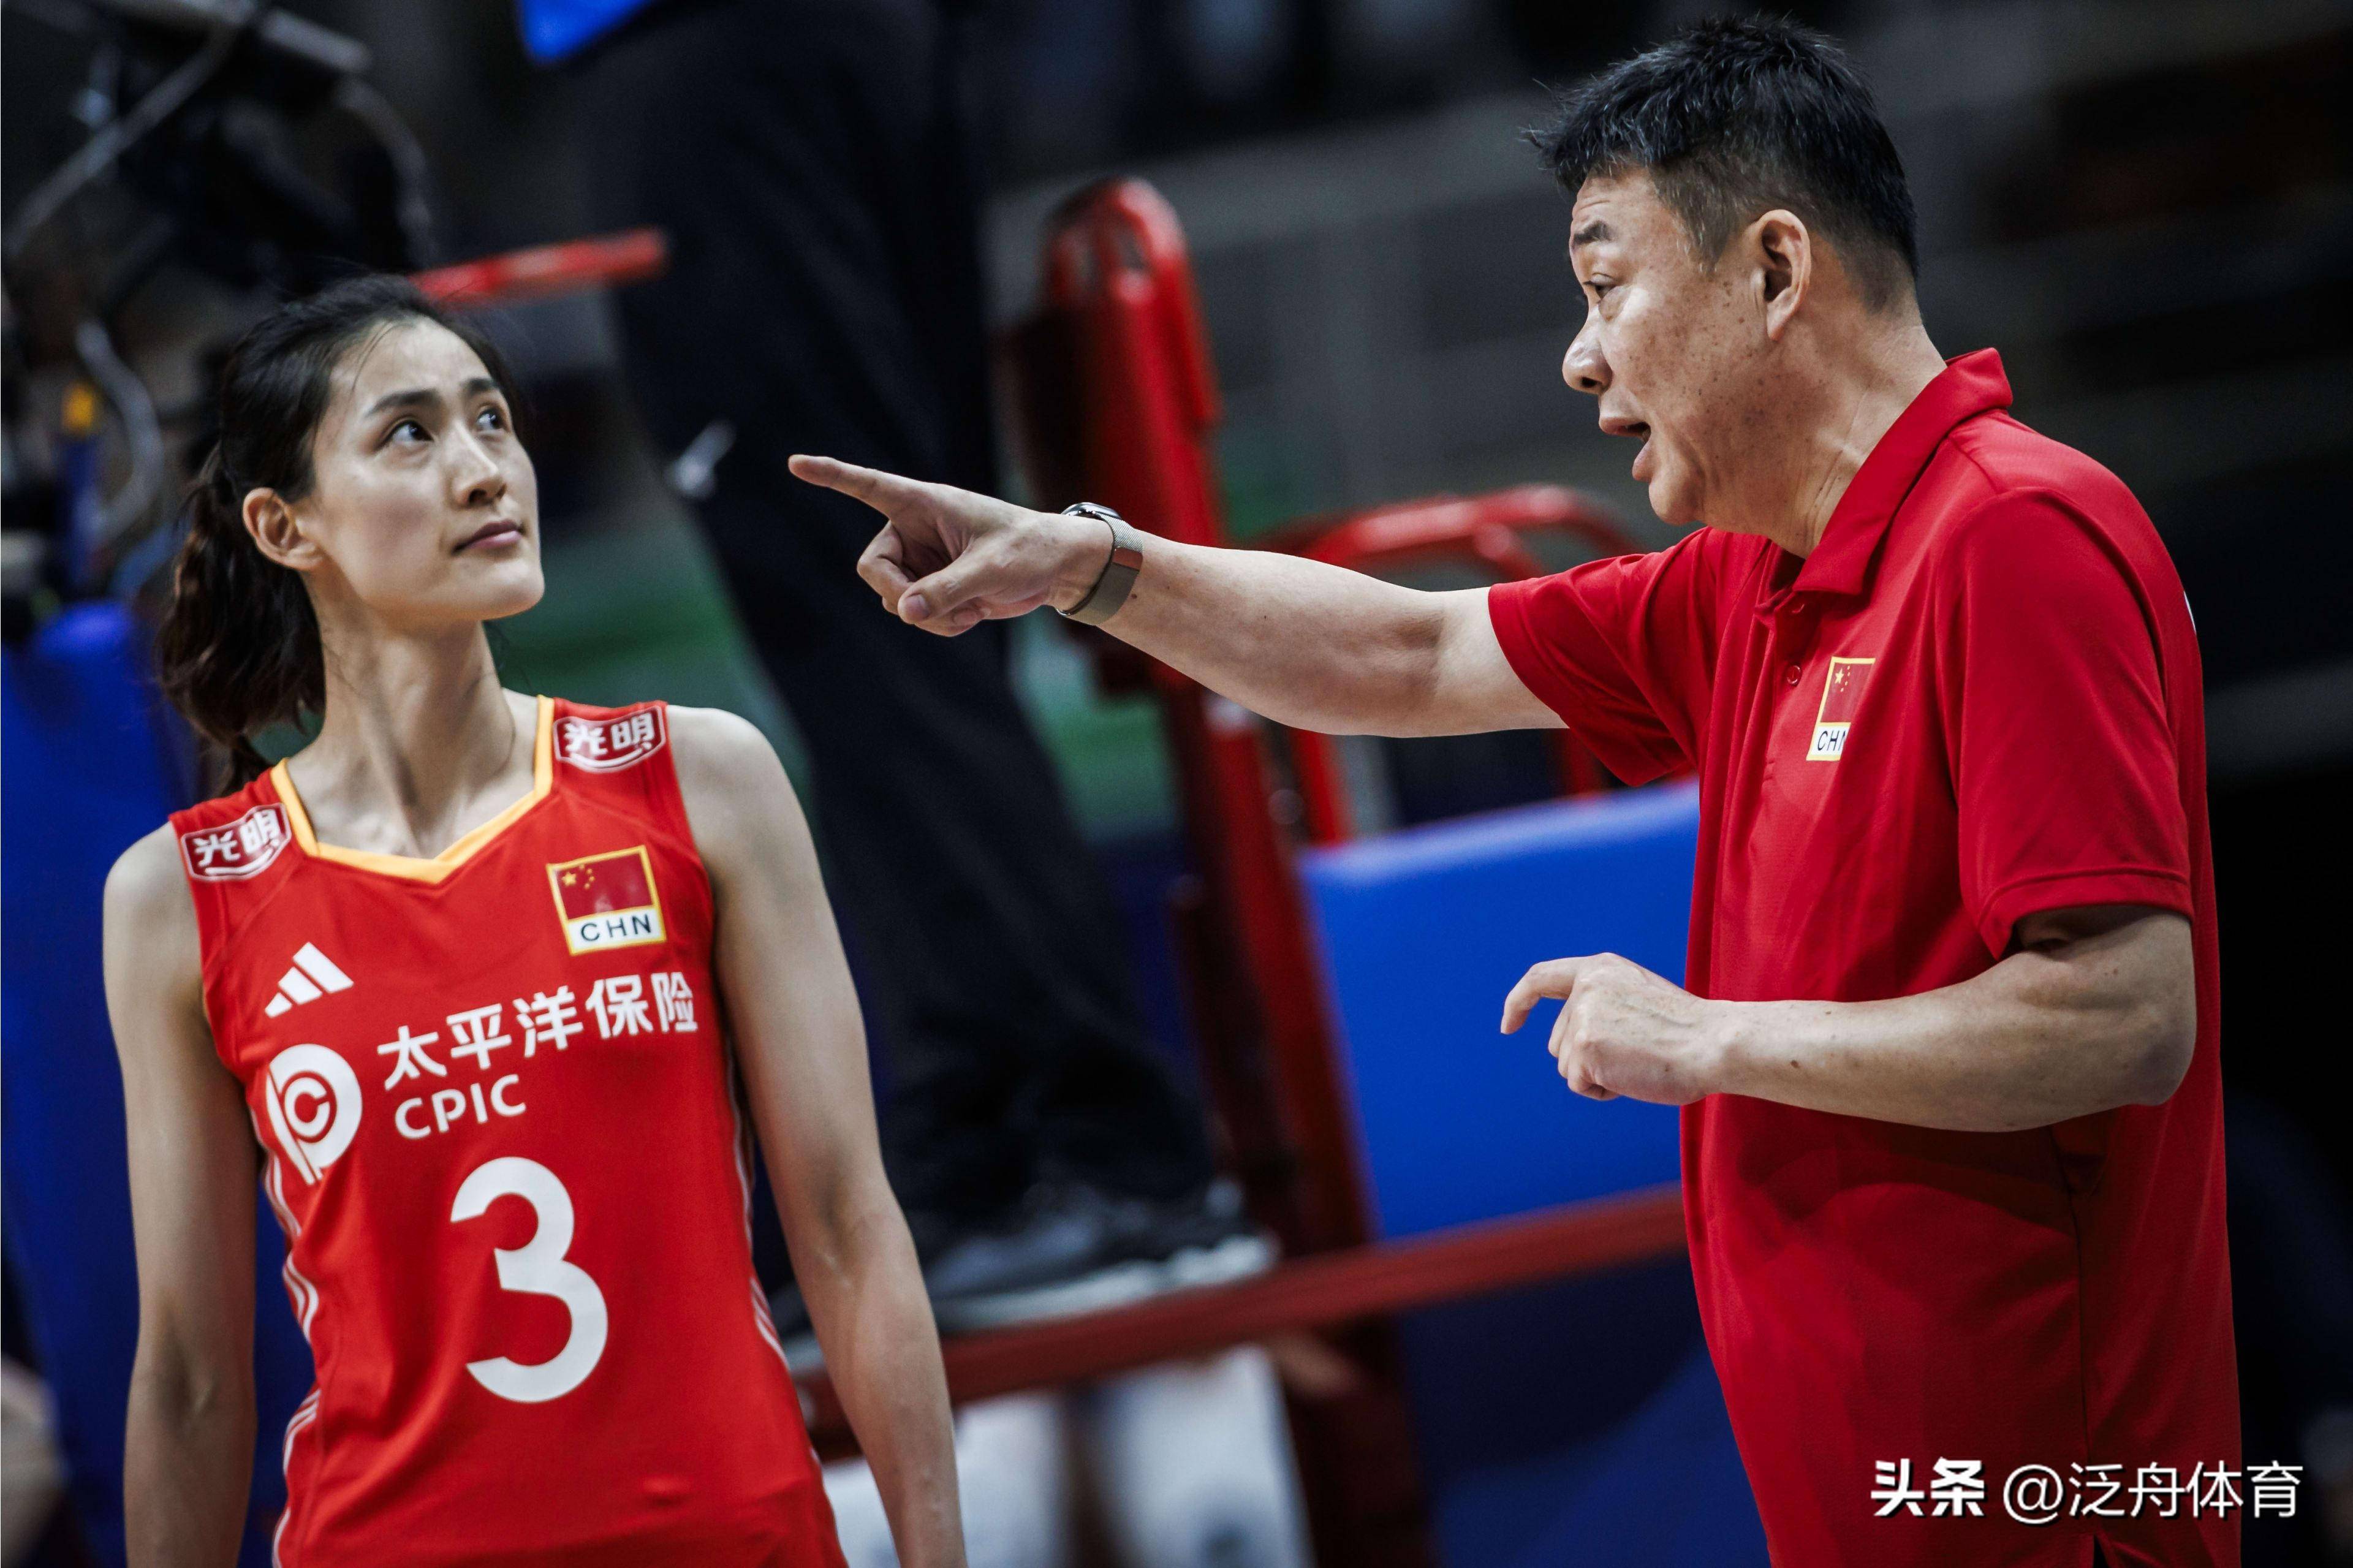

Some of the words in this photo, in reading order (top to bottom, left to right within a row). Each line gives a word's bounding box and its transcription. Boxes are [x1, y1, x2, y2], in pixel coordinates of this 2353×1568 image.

[564, 711, 656, 756] 光明
[194, 808, 281, 868] 光明
[579, 914, 652, 942] CHN
[377, 971, 698, 1090] 太平洋保险
[395, 1074, 526, 1139] CPIC
[450, 1156, 608, 1403] 3
